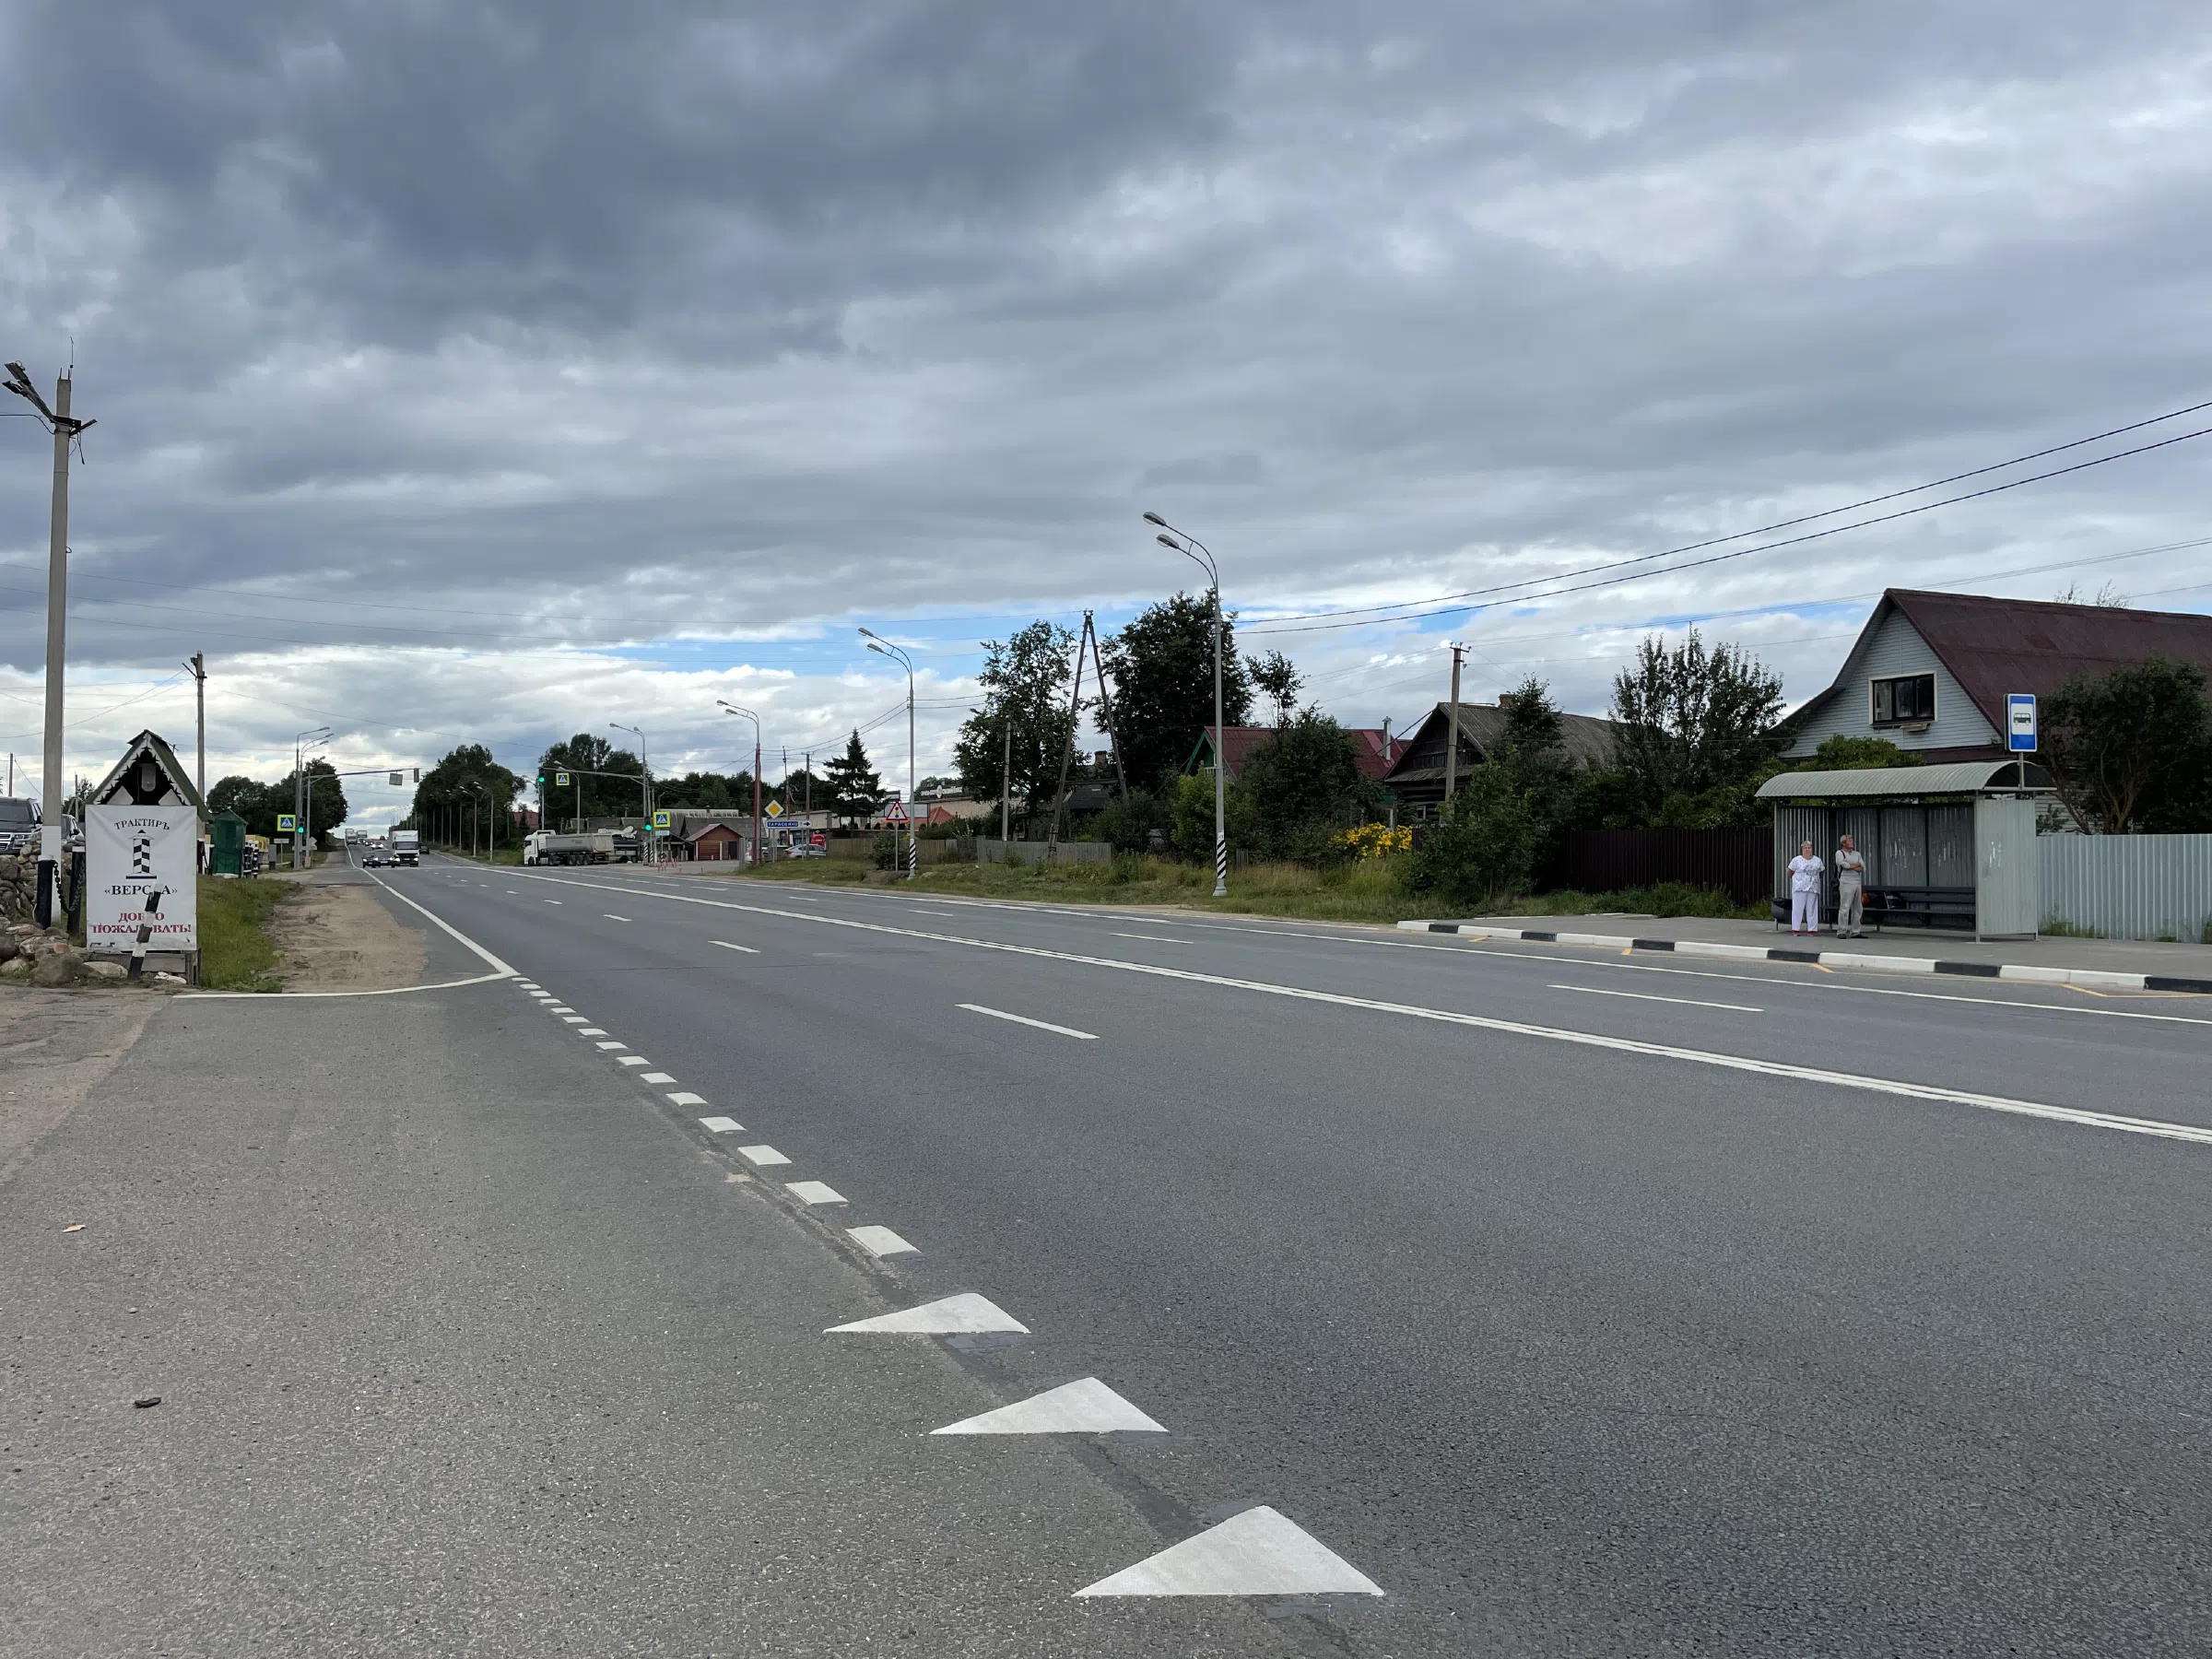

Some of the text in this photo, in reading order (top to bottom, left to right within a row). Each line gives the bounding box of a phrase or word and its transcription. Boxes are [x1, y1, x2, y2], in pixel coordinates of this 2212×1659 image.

[114, 818, 171, 830] ТРАКТИРЪ
[104, 885, 178, 896] «ВЕРСА»
[118, 912, 165, 923] ДОБО
[92, 924, 192, 933] ПОЖАВАТЬ!
